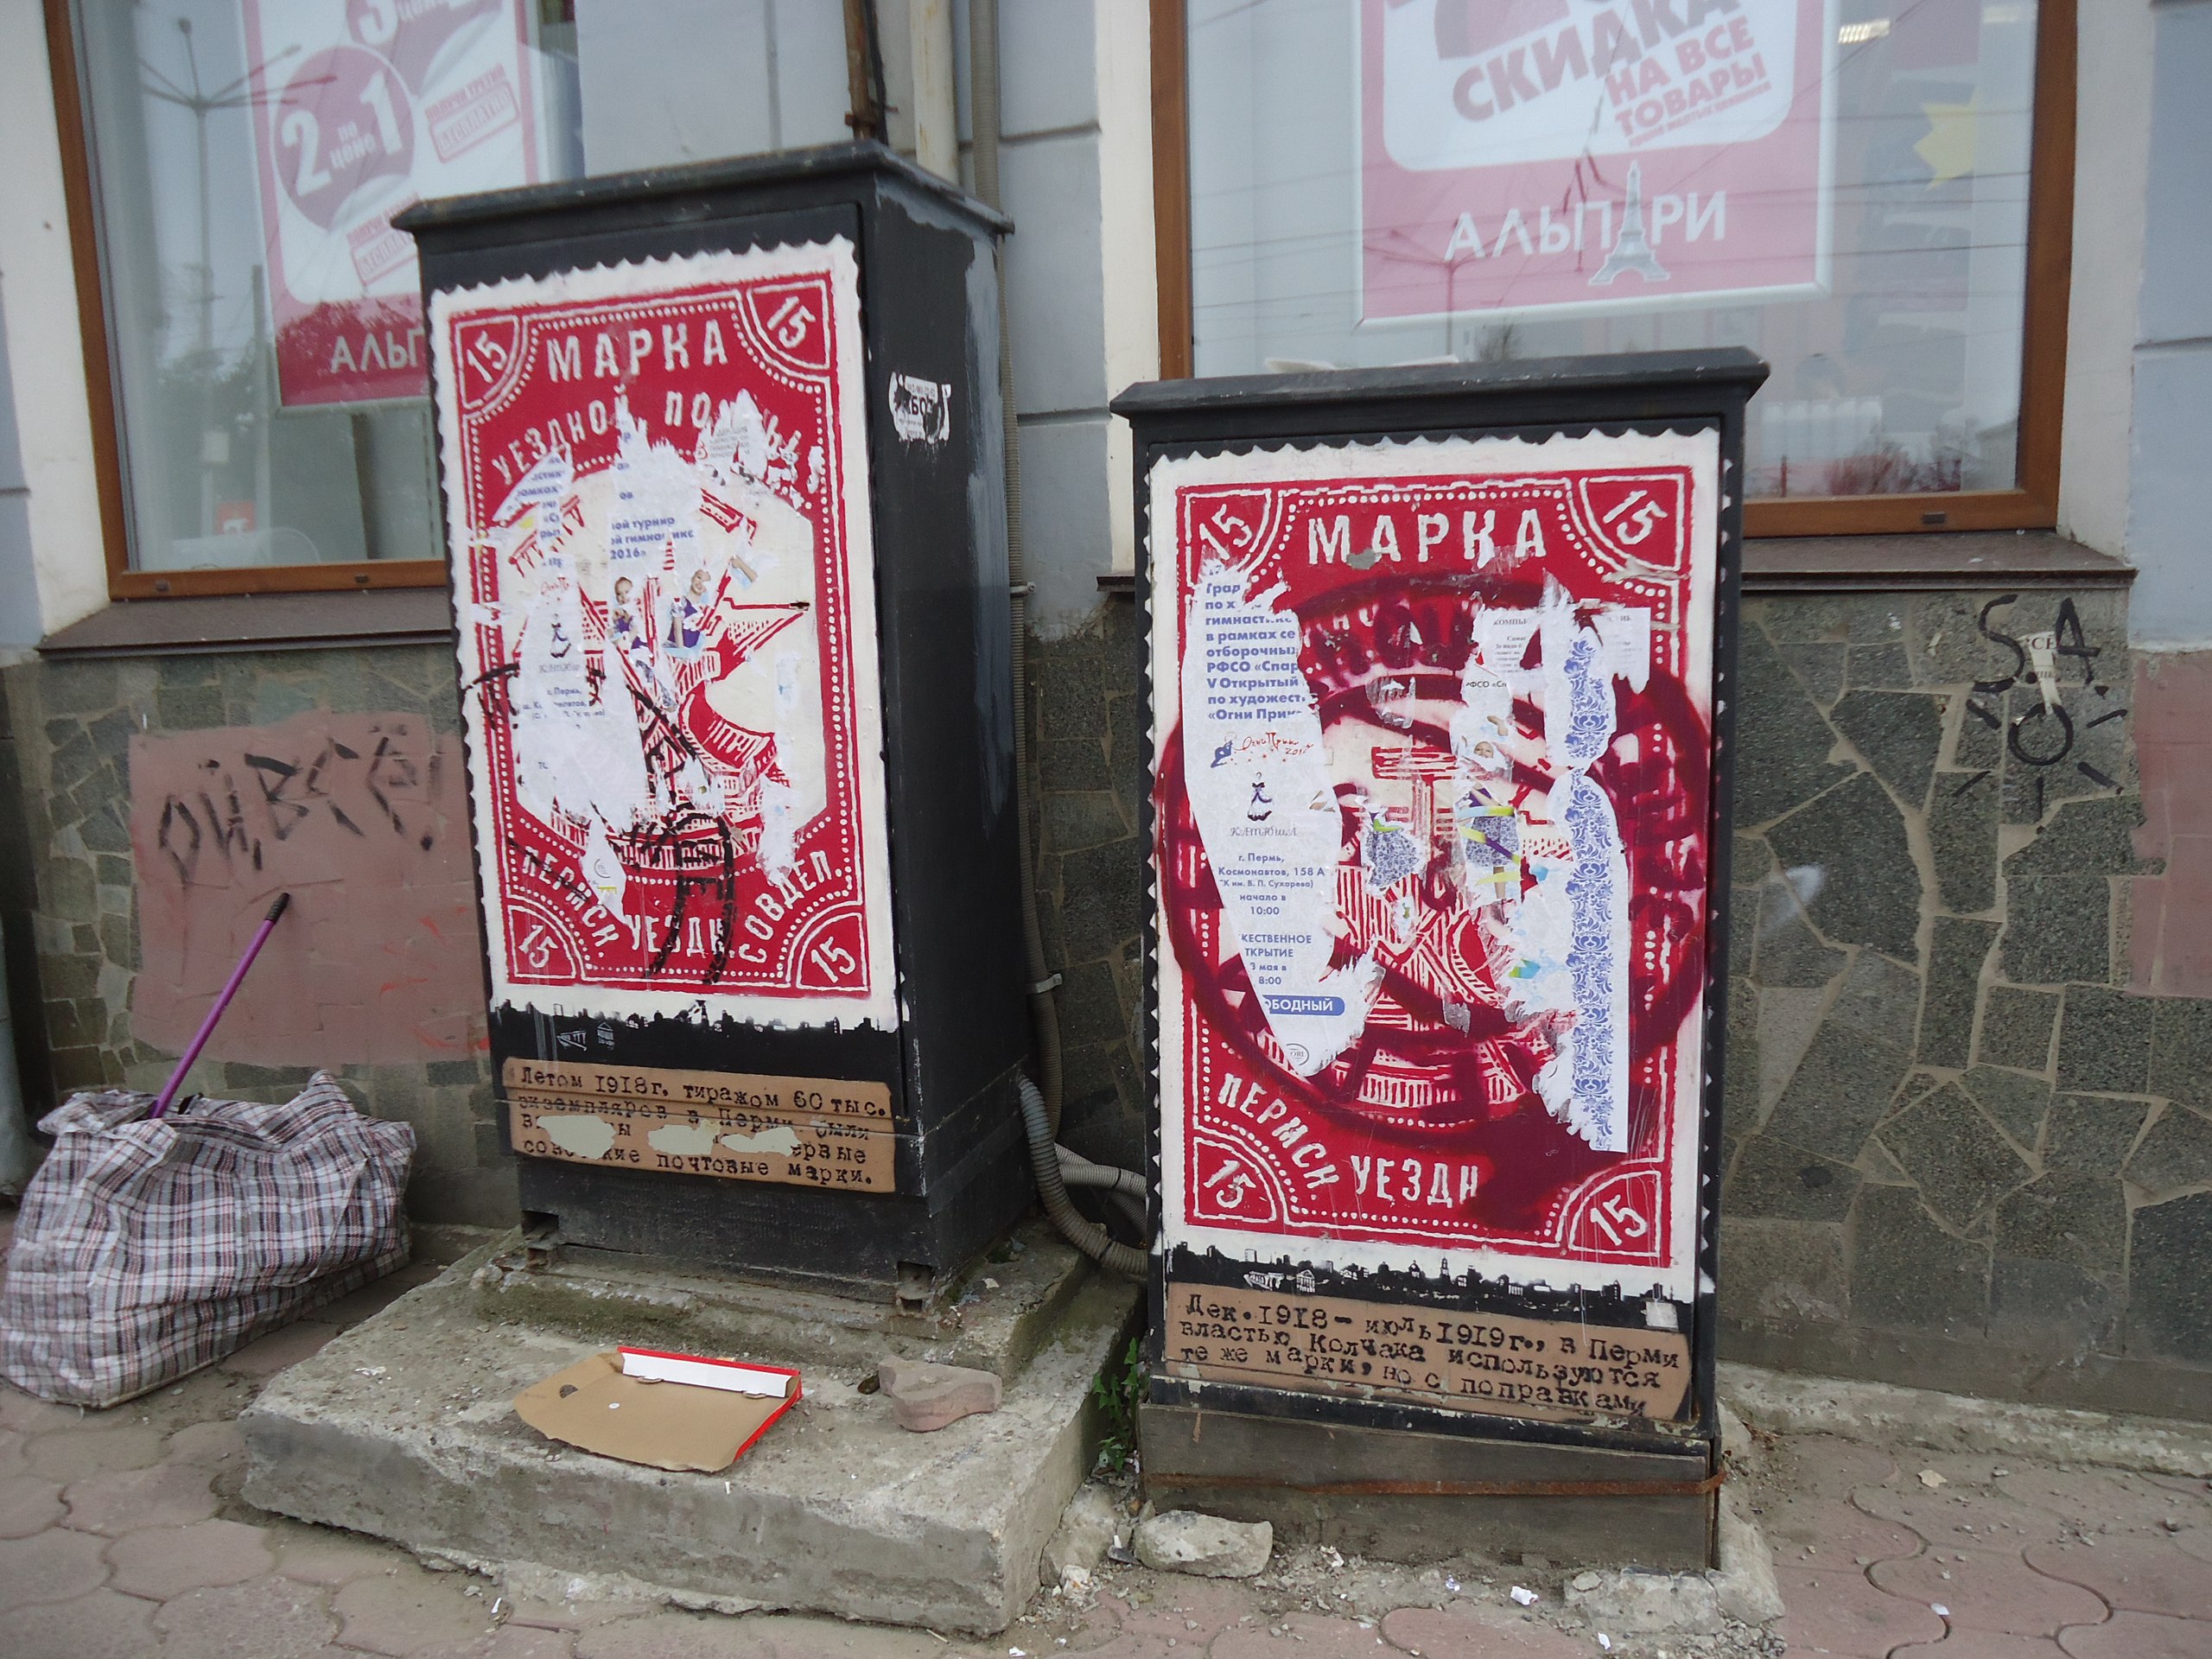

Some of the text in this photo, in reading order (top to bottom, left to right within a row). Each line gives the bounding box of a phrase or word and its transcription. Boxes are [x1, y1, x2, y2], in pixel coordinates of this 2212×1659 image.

[1605, 15, 1755, 108] НА ВСЕ
[359, 69, 404, 156] 1
[1614, 51, 1767, 137] ТОВАРЫ
[281, 109, 332, 197] 2
[766, 296, 817, 349] 15
[467, 331, 508, 383] 15
[546, 319, 730, 384] МАРКА
[1198, 504, 1252, 559] 15
[1308, 508, 1548, 566] МАРКА
[1602, 490, 1669, 546] 15
[1205, 601, 1224, 610] по
[1206, 631, 1296, 645] в рамках се
[1207, 661, 1251, 673] РФСО
[1207, 676, 1299, 691] V Открытый
[1208, 696, 1226, 704] по
[1208, 709, 1253, 721] «Огни
[1218, 867, 1325, 877] Космонавтов, 158 А
[1248, 853, 1285, 863] Пермь,
[1268, 880, 1313, 889] Сухарева)
[1250, 906, 1280, 915] 10:00
[518, 924, 558, 969] 15
[811, 938, 856, 983] 15
[520, 1066, 583, 1088] Летом
[683, 1084, 779, 1109] тиражом
[793, 1090, 823, 1111] 60
[830, 1098, 886, 1117] тыс.
[656, 1154, 769, 1177] почтовые
[788, 1163, 872, 1185] марки.
[1203, 1160, 1256, 1209] 15
[1589, 1195, 1649, 1247] 15
[1179, 1321, 1661, 1388] властью Колчака используются
[1560, 1337, 1577, 1354] в
[1589, 1338, 1679, 1369] Перми
[1180, 1345, 1646, 1417] те же марки, но с поправками
